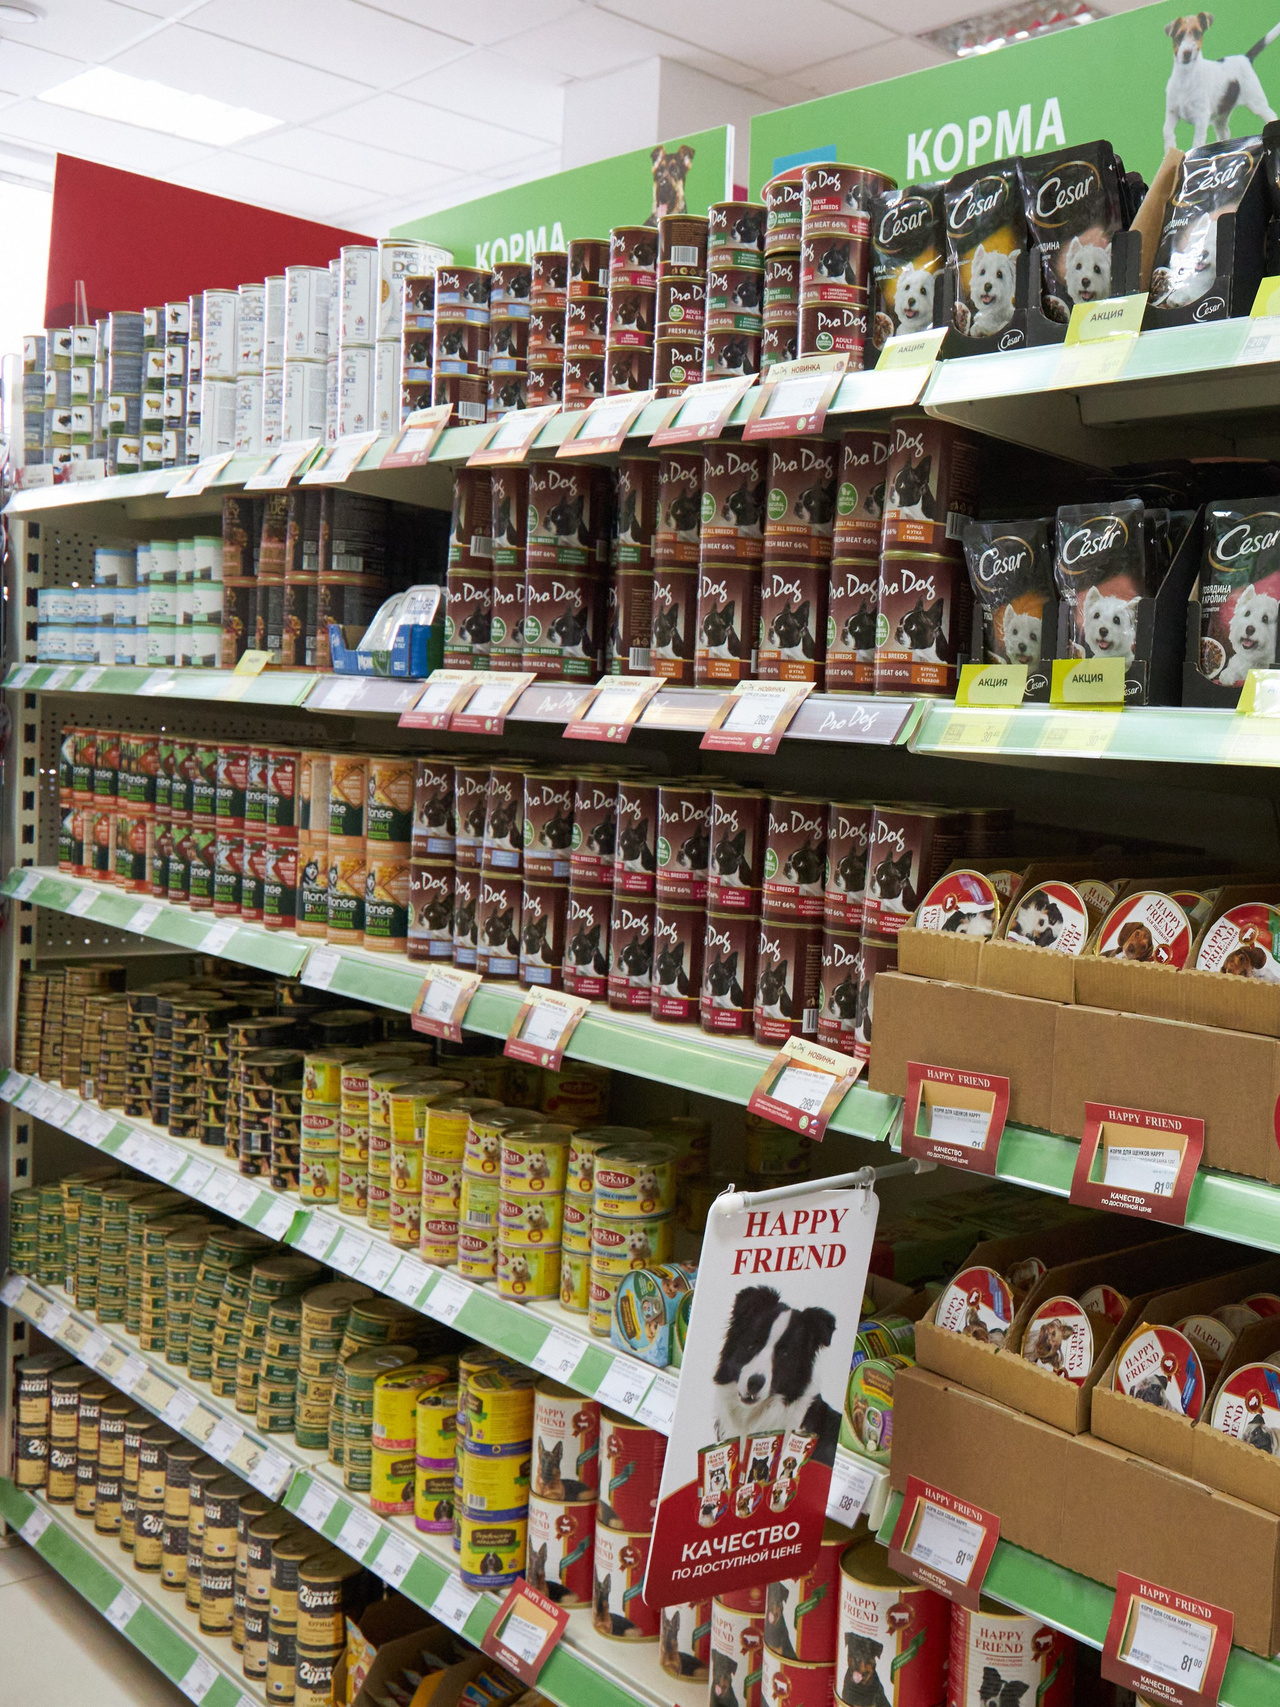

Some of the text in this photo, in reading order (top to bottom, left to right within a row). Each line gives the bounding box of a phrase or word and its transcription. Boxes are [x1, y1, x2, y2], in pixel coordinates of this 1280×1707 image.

[906, 98, 1066, 181] КОРМА
[950, 186, 1004, 229] Cesar
[1036, 175, 1095, 218] Cesar
[878, 208, 929, 245] Cesar
[475, 221, 567, 270] КОРМА
[817, 310, 867, 332] Pro Dog
[1090, 309, 1124, 323] АКЦИЯ
[898, 342, 925, 354] АКЦИЯ
[791, 364, 821, 374] НОВИНКА
[772, 448, 833, 479] Pro Dog
[1063, 528, 1121, 564] Cesar
[901, 570, 935, 600] Dog
[978, 678, 1007, 687] АКЦИЯ
[1072, 673, 1103, 683] АКЦИЯ
[819, 706, 879, 732] Pro Dog
[424, 769, 448, 791] Dog
[791, 811, 823, 840] Dog
[1145, 904, 1176, 938] FRIEND
[1154, 898, 1183, 929] HAPPY
[808, 1050, 836, 1066] НОВИНКА
[799, 1098, 814, 1110] 289
[1109, 1110, 1182, 1130] HAPPY FRIEND
[743, 1208, 849, 1238] HAPPY
[730, 1243, 847, 1276] FRIEND
[681, 1522, 800, 1562] КАЧЕСТВО
[672, 1543, 802, 1581] ПО ДОСТУПНОЙ ЦЕНЕ
[955, 1550, 974, 1566] 81 00
[1139, 1584, 1212, 1619] HAPPY FRIEND
[975, 1639, 1024, 1653] FRIEND
[980, 1628, 1024, 1641] HAPPY
